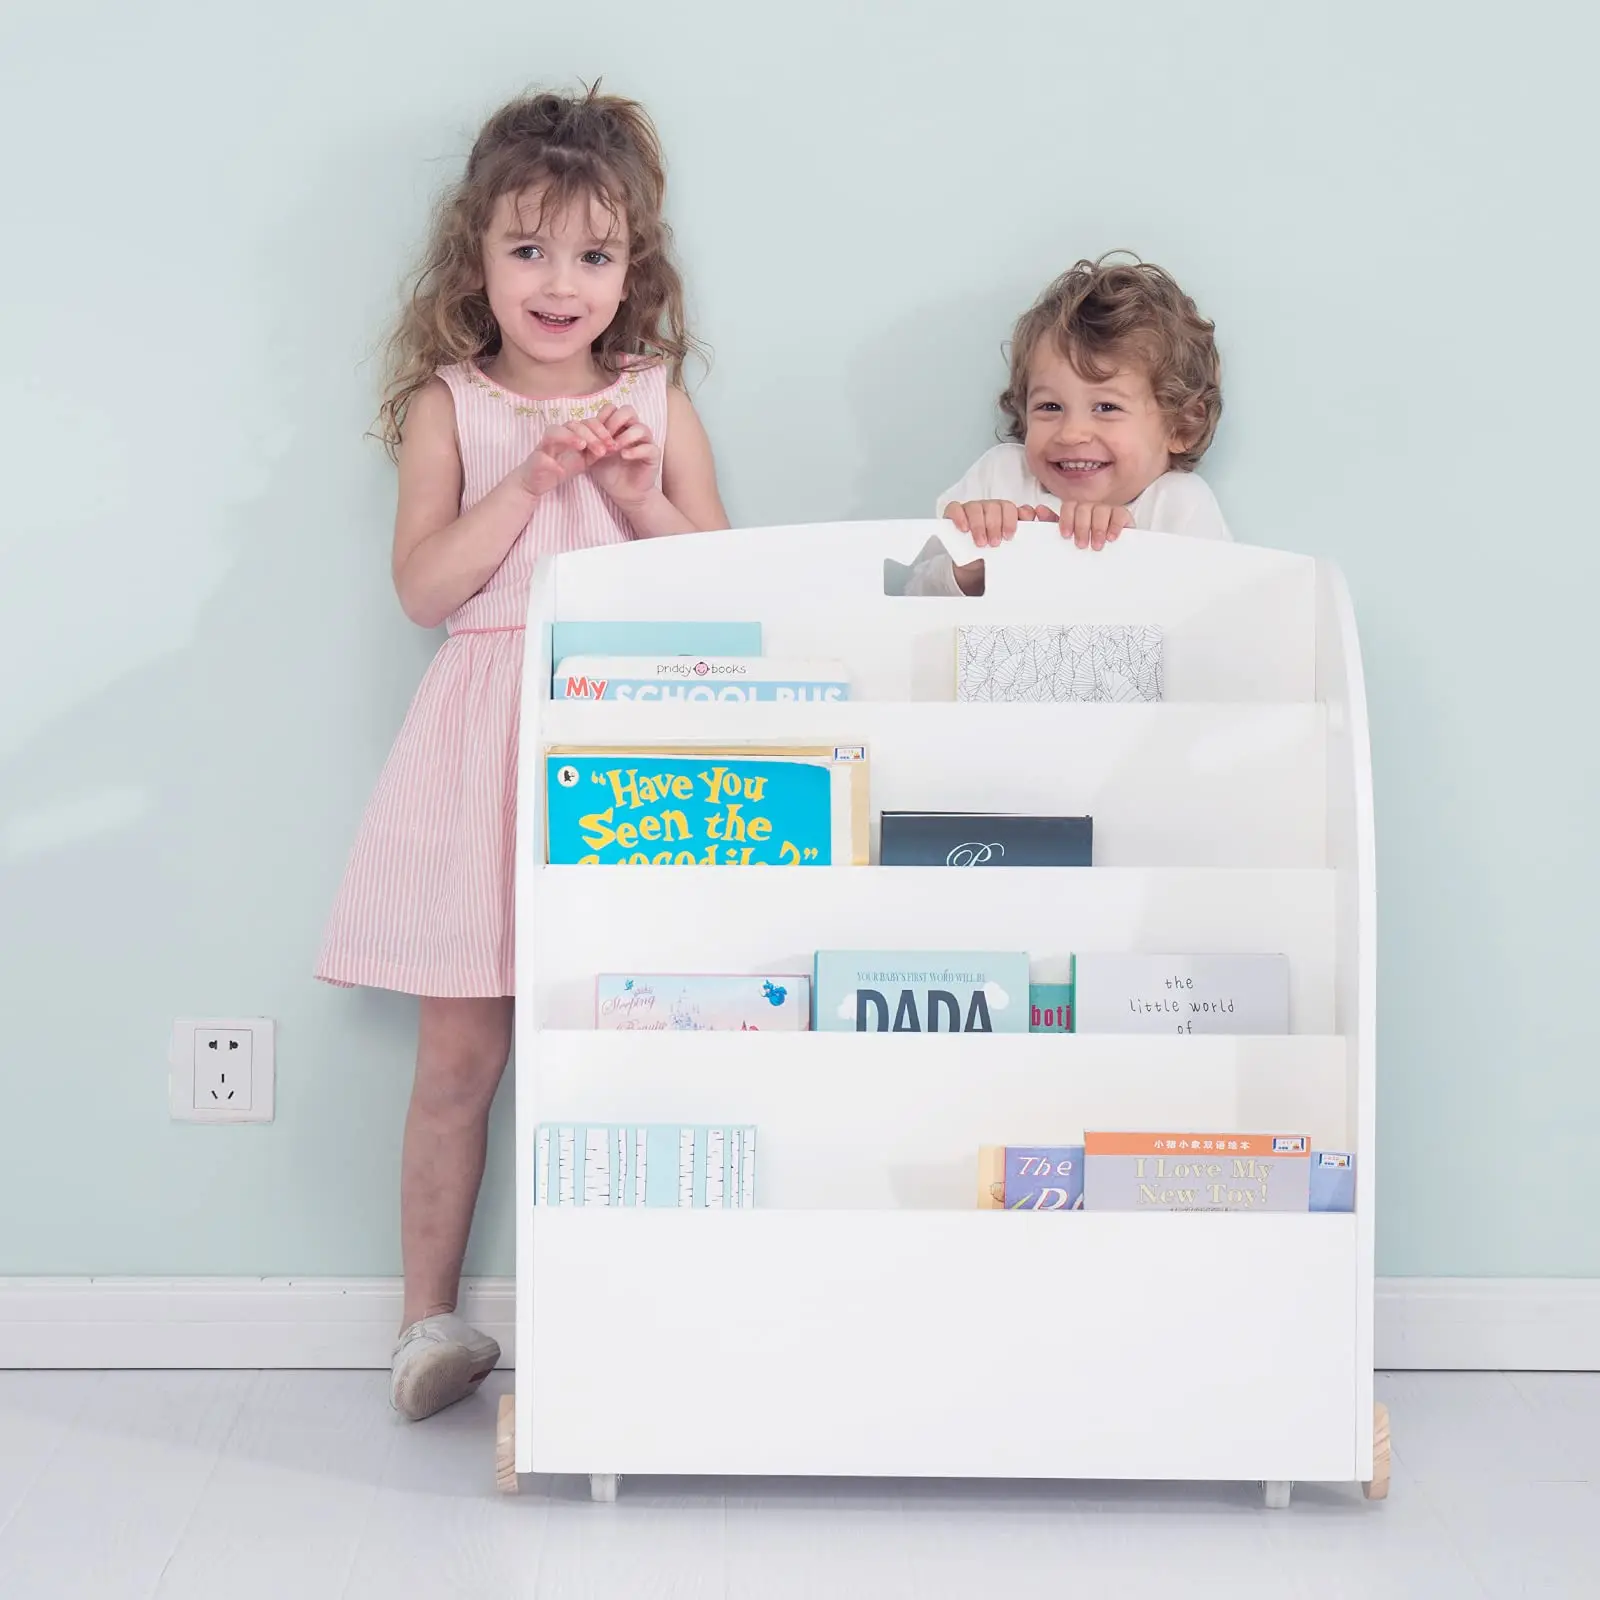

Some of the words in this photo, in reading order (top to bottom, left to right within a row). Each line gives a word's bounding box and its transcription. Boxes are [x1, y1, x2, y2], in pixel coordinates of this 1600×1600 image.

[656, 664, 692, 677] priddy
[711, 664, 747, 674] books
[565, 676, 607, 700] My
[697, 767, 769, 804] You
[578, 806, 694, 850] Seen
[703, 803, 773, 842] the
[1164, 975, 1195, 989] the
[856, 989, 994, 1033] DADA
[1129, 999, 1180, 1014] little
[1191, 999, 1235, 1013] world
[1176, 1020, 1194, 1034] of
[1018, 1156, 1073, 1177] The
[1134, 1157, 1147, 1179] I
[1155, 1158, 1223, 1179] Love
[1230, 1158, 1274, 1183] My
[1138, 1184, 1200, 1205] New
[1206, 1184, 1269, 1207] Toy!
